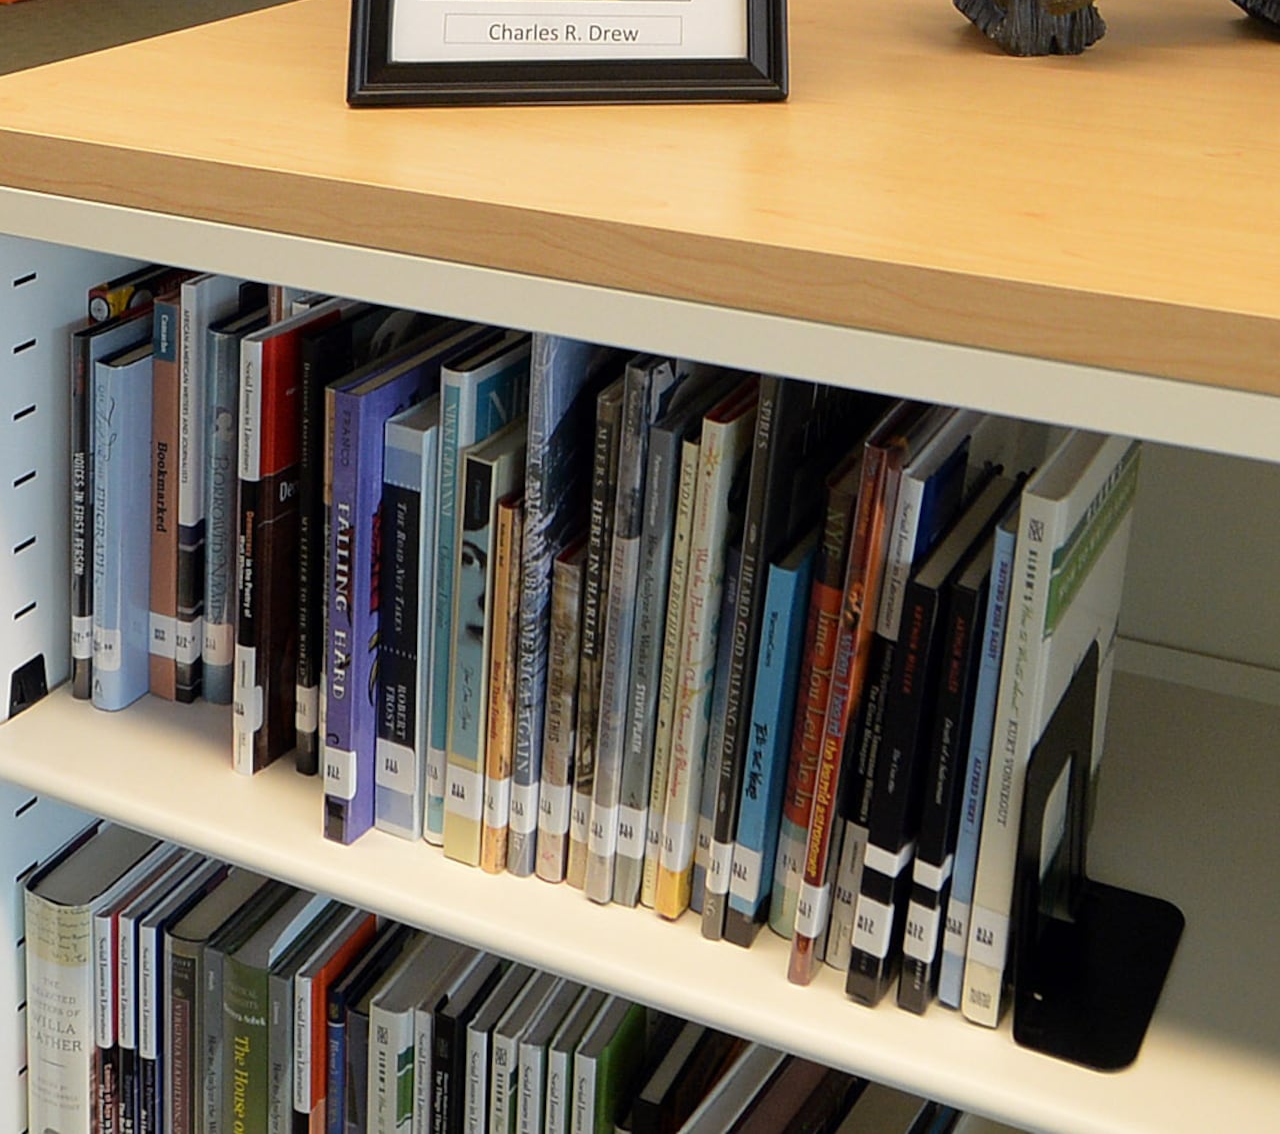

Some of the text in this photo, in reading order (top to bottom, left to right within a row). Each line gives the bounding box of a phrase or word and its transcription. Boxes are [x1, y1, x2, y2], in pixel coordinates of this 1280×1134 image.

[489, 23, 639, 42] Charles R. Drew
[243, 361, 254, 474] Social Issues Literature
[341, 409, 352, 467] FRANCO
[757, 398, 772, 450] SPIRES
[156, 441, 168, 534] Bookmarked
[441, 402, 457, 518] NIKKI GIOVANNI
[72, 452, 85, 576] VOICES IN FIRST PERSON
[678, 463, 692, 519] SENDAK
[584, 427, 608, 657] MYERS HERE IN HARLEM
[822, 507, 845, 560] NYE
[394, 502, 408, 633] THE ROAD NOT TAKEN
[737, 565, 754, 618] HEARD
[885, 500, 913, 629] Social Issues Literature
[332, 502, 351, 700] FALLING HARD
[516, 431, 543, 775] LET AGAIN
[734, 621, 748, 657] GOD
[903, 604, 924, 696] ARTHUR MILLER
[947, 617, 966, 694] ARTHUR MILLER
[988, 630, 1001, 661] DAISY
[384, 685, 395, 732] FROST
[634, 683, 646, 719] SYLVIA
[661, 665, 674, 704] BOOK
[725, 662, 745, 728] TALKING
[808, 664, 832, 701] You
[996, 549, 1038, 828] BLOOM'S KURT VONNEGUT
[396, 683, 407, 739] ROBERT
[631, 719, 645, 754] PLATH
[802, 706, 823, 741] Let
[722, 734, 735, 755] TO
[797, 743, 819, 785] Me
[793, 786, 814, 809] In
[807, 693, 848, 878] heard the astronomer
[99, 937, 108, 1040] Social Issues Literature
[120, 936, 129, 1040] Social Issues Literature
[142, 947, 151, 1053] Social Issues Literature
[232, 1035, 251, 1066] The
[296, 997, 306, 1103] Social Issues Literature
[231, 1068, 249, 1118] House
[577, 1076, 587, 1104] Social
